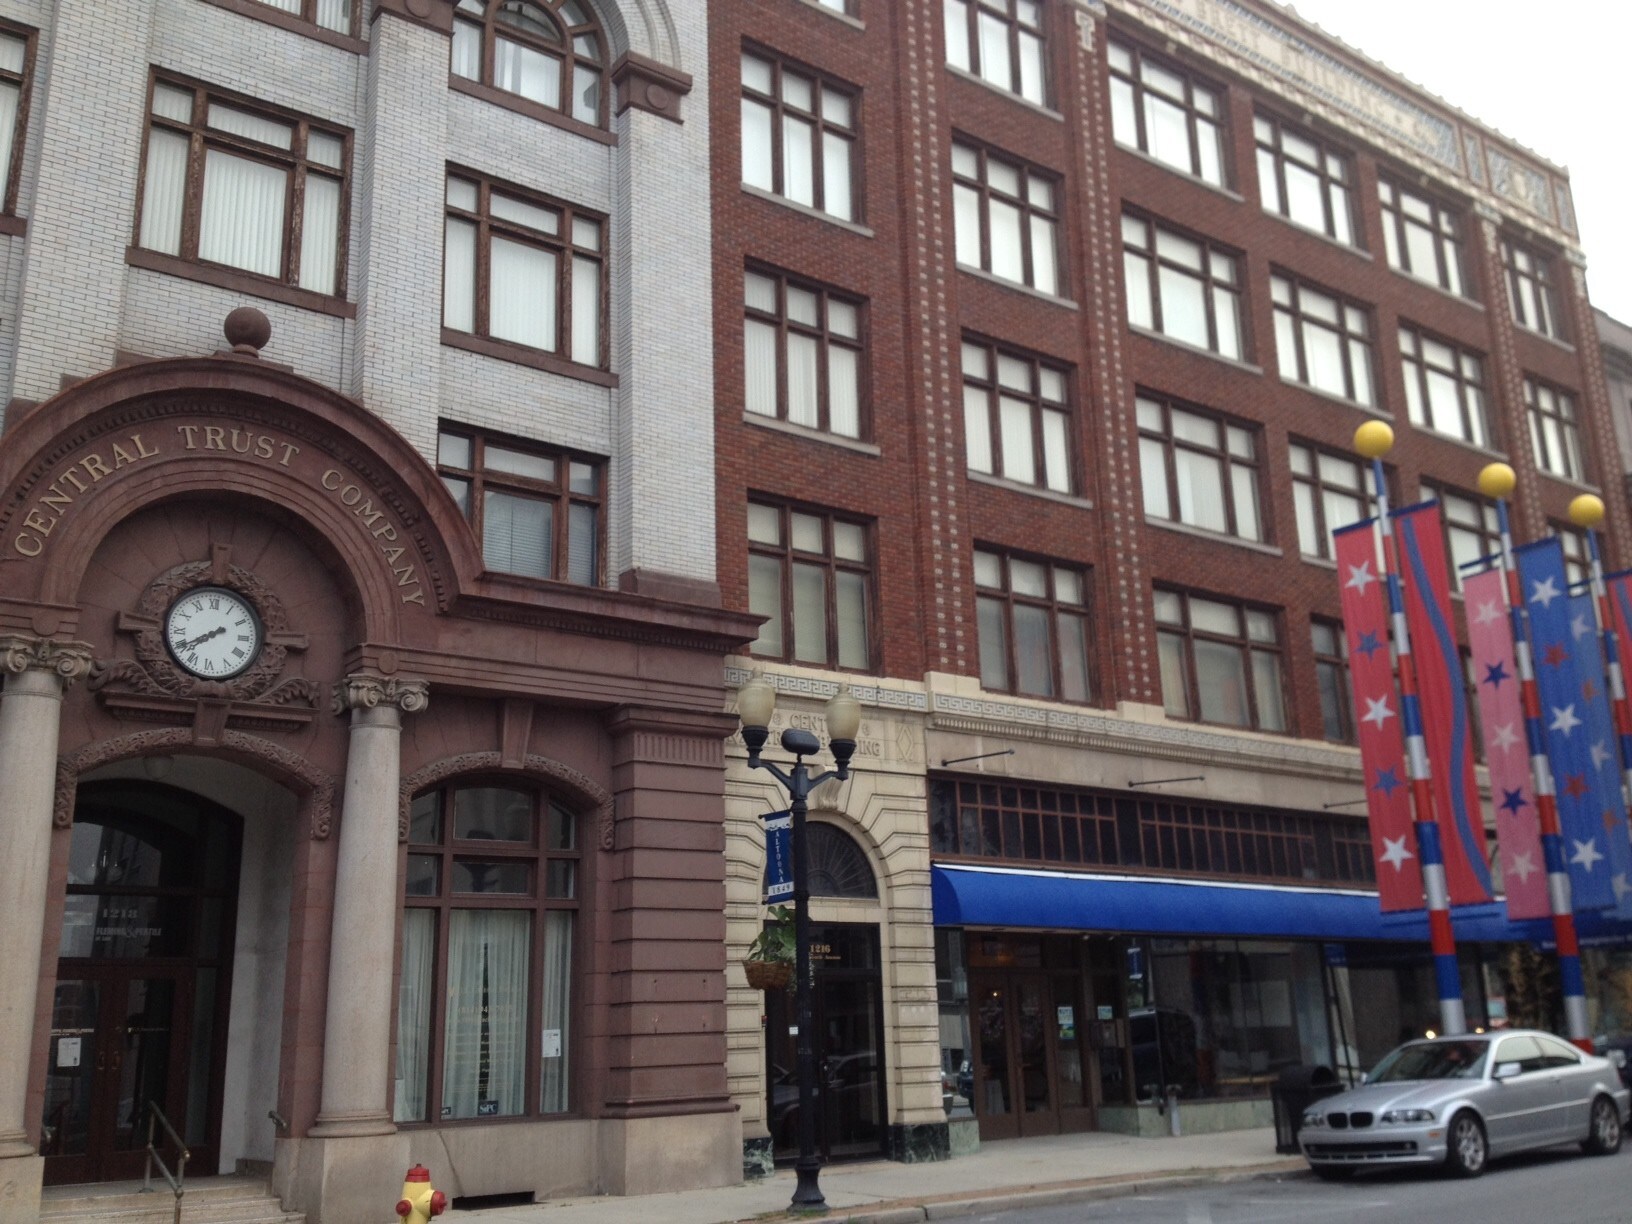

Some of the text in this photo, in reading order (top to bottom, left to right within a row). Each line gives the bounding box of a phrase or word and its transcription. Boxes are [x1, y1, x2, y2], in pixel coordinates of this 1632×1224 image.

[14, 425, 426, 609] CENTRAL TRUST COMPANY
[775, 831, 784, 883] ALTOONA
[772, 884, 791, 895] 1849
[810, 944, 831, 953] 1216
